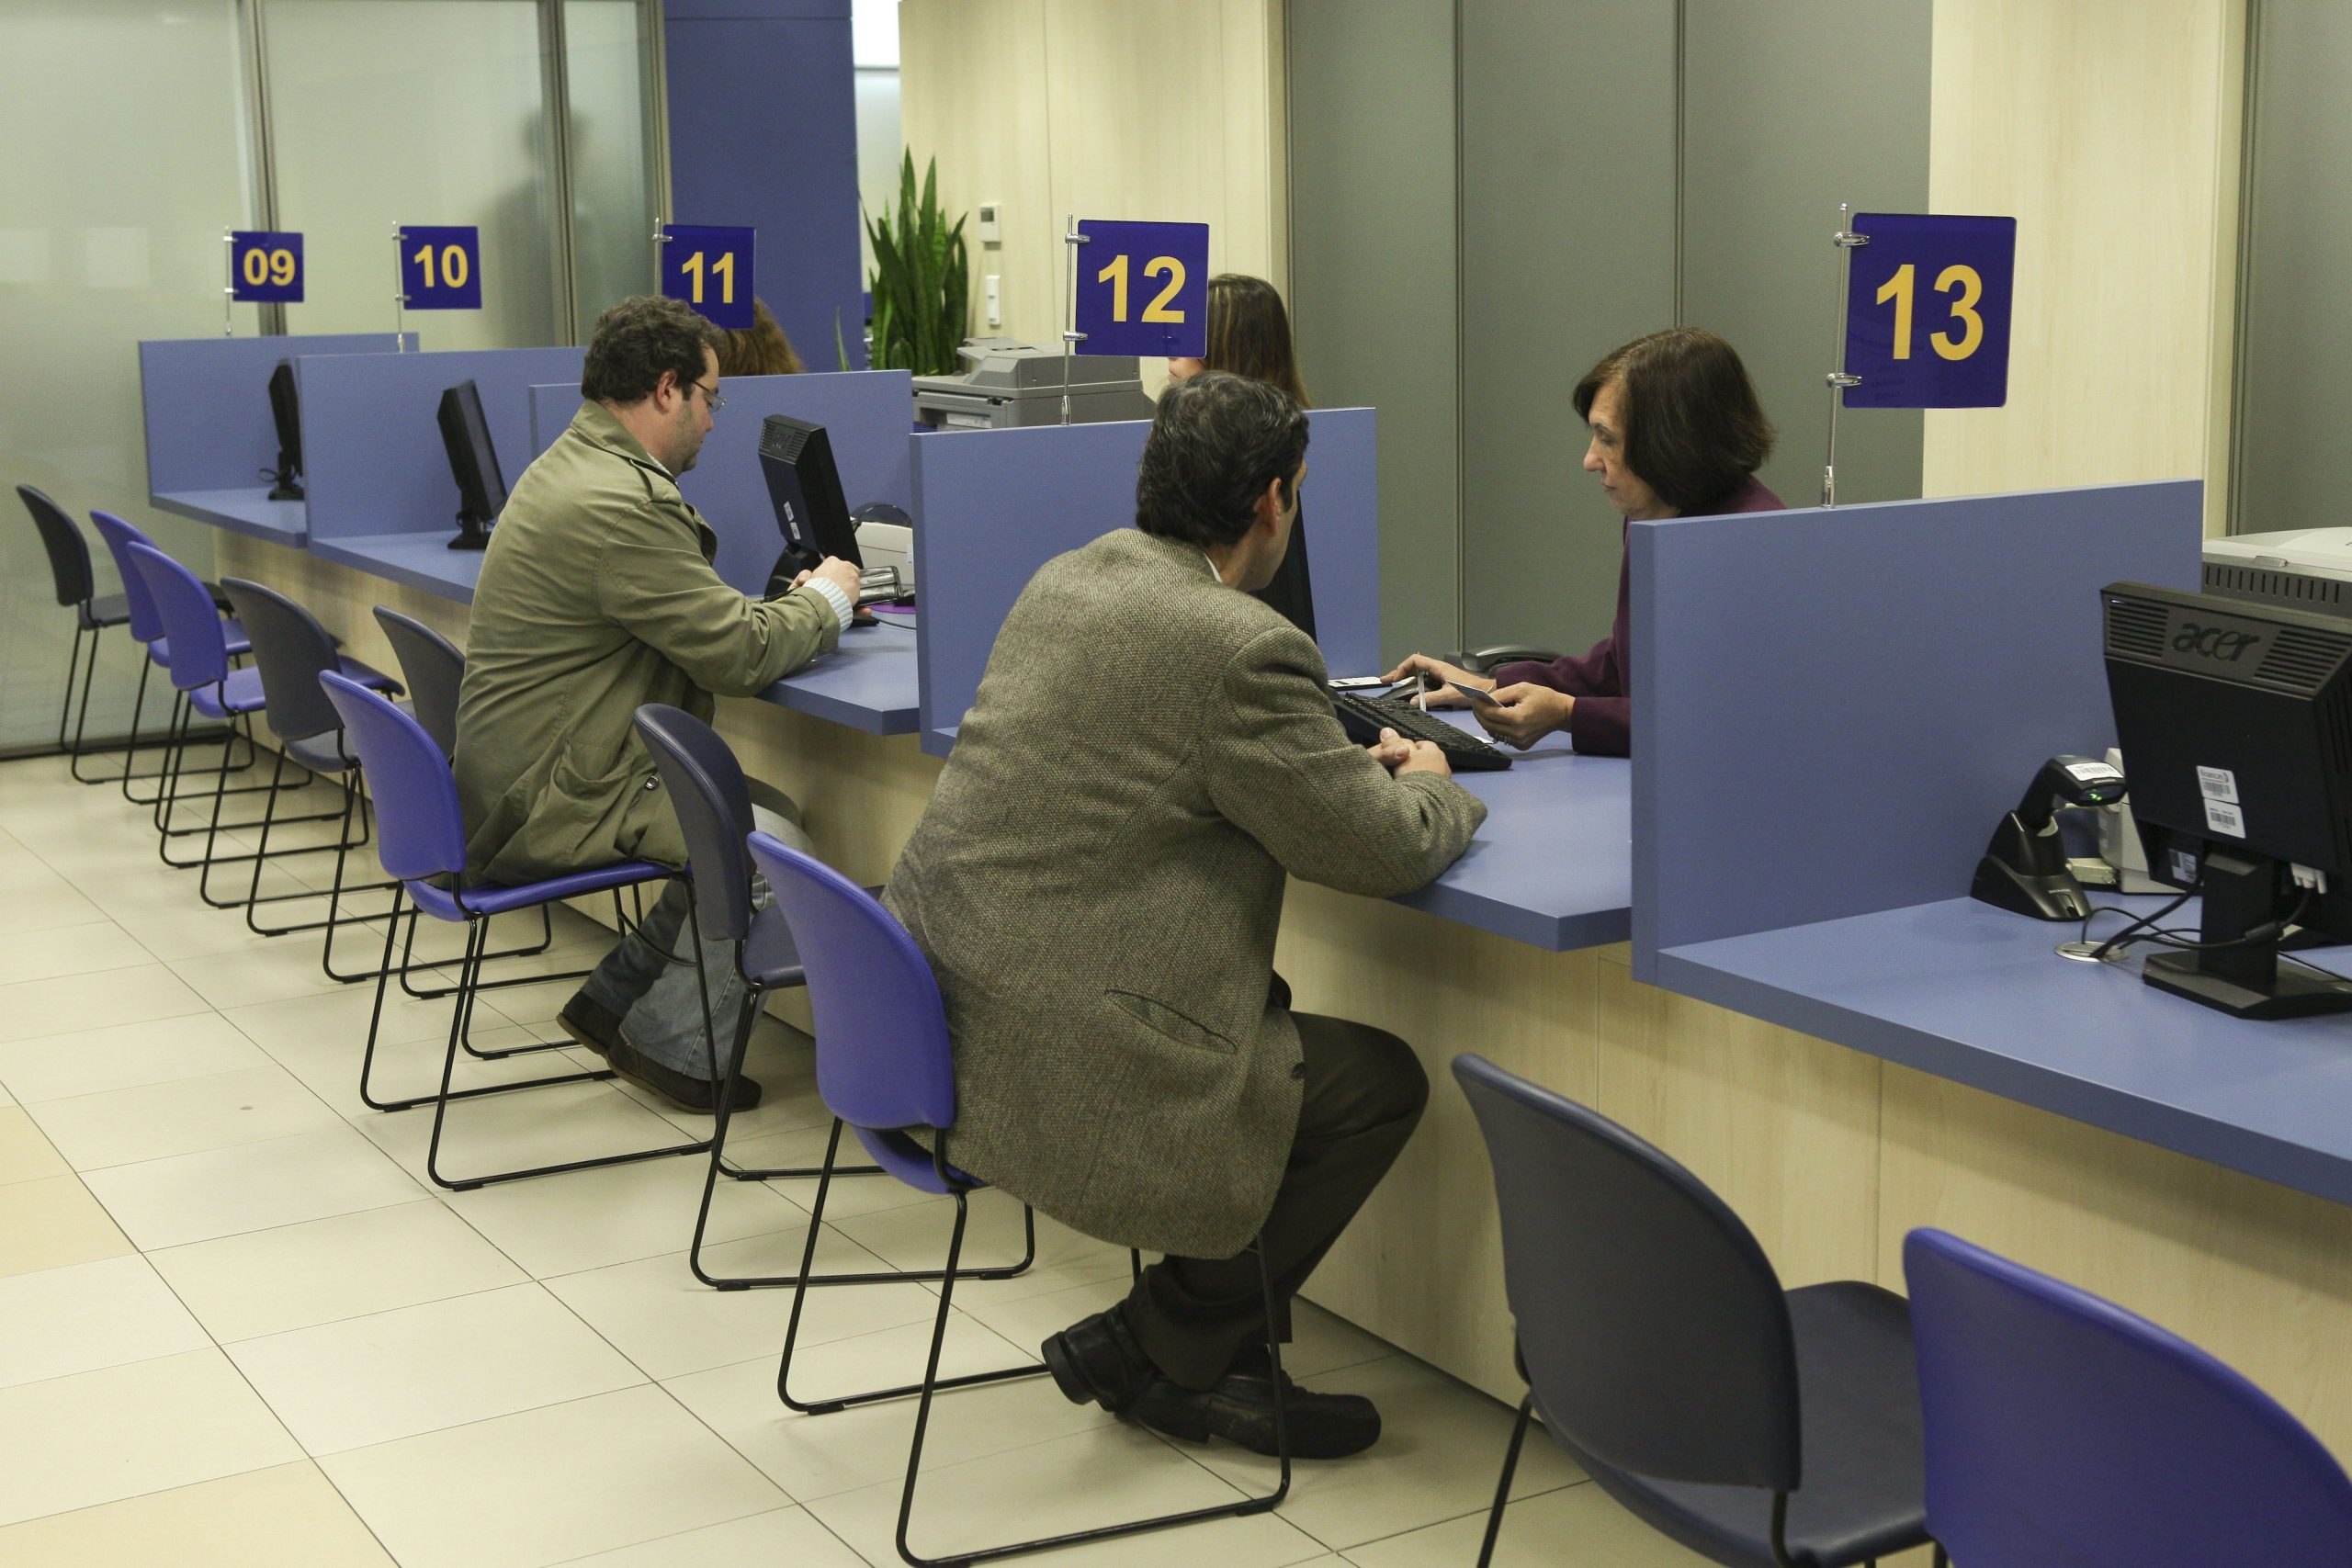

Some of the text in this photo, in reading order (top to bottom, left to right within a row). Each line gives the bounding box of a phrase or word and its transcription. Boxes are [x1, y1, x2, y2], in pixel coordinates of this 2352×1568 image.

[243, 248, 295, 286] 09
[414, 245, 469, 288] 10
[682, 252, 734, 303] 11
[1098, 255, 1185, 322] 12
[1877, 264, 1984, 360] 13
[2172, 624, 2259, 661] acer
